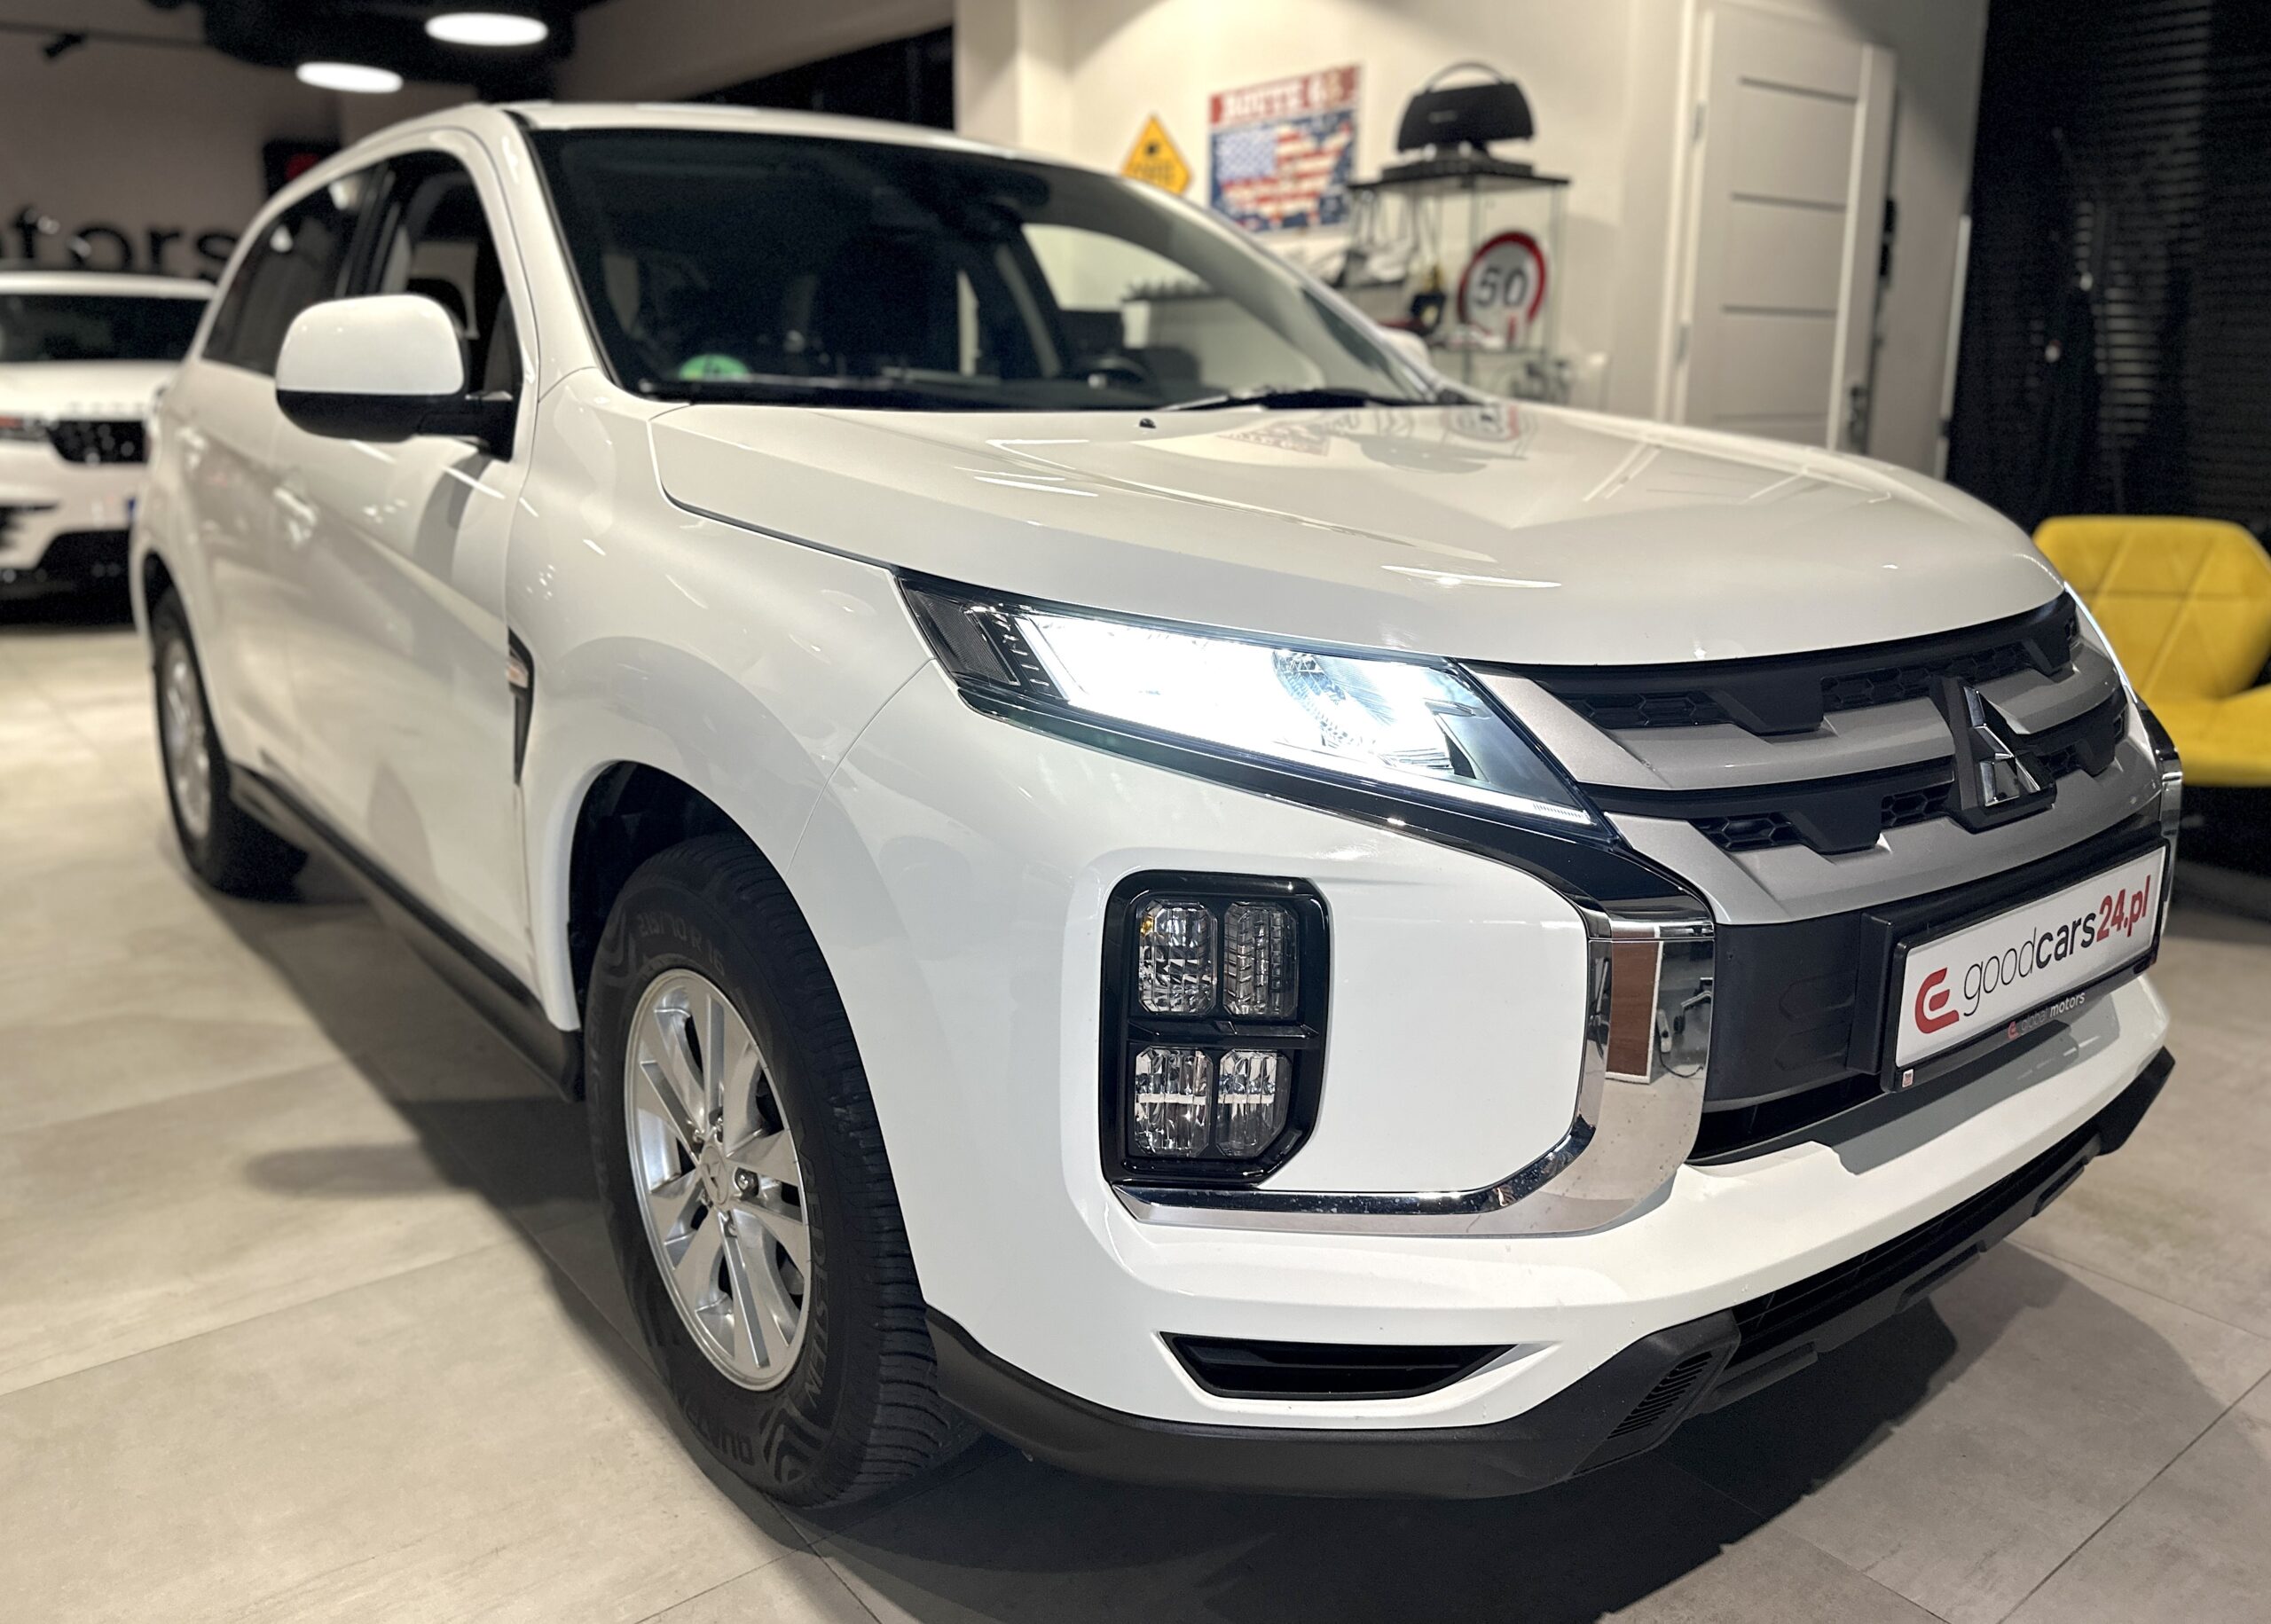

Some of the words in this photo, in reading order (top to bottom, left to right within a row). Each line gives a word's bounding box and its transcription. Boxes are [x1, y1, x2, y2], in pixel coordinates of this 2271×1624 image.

[0, 207, 240, 277] tors
[1475, 267, 1527, 308] 50
[1963, 875, 2151, 1017] goodcars24.pl
[2050, 992, 2086, 1018] motors
